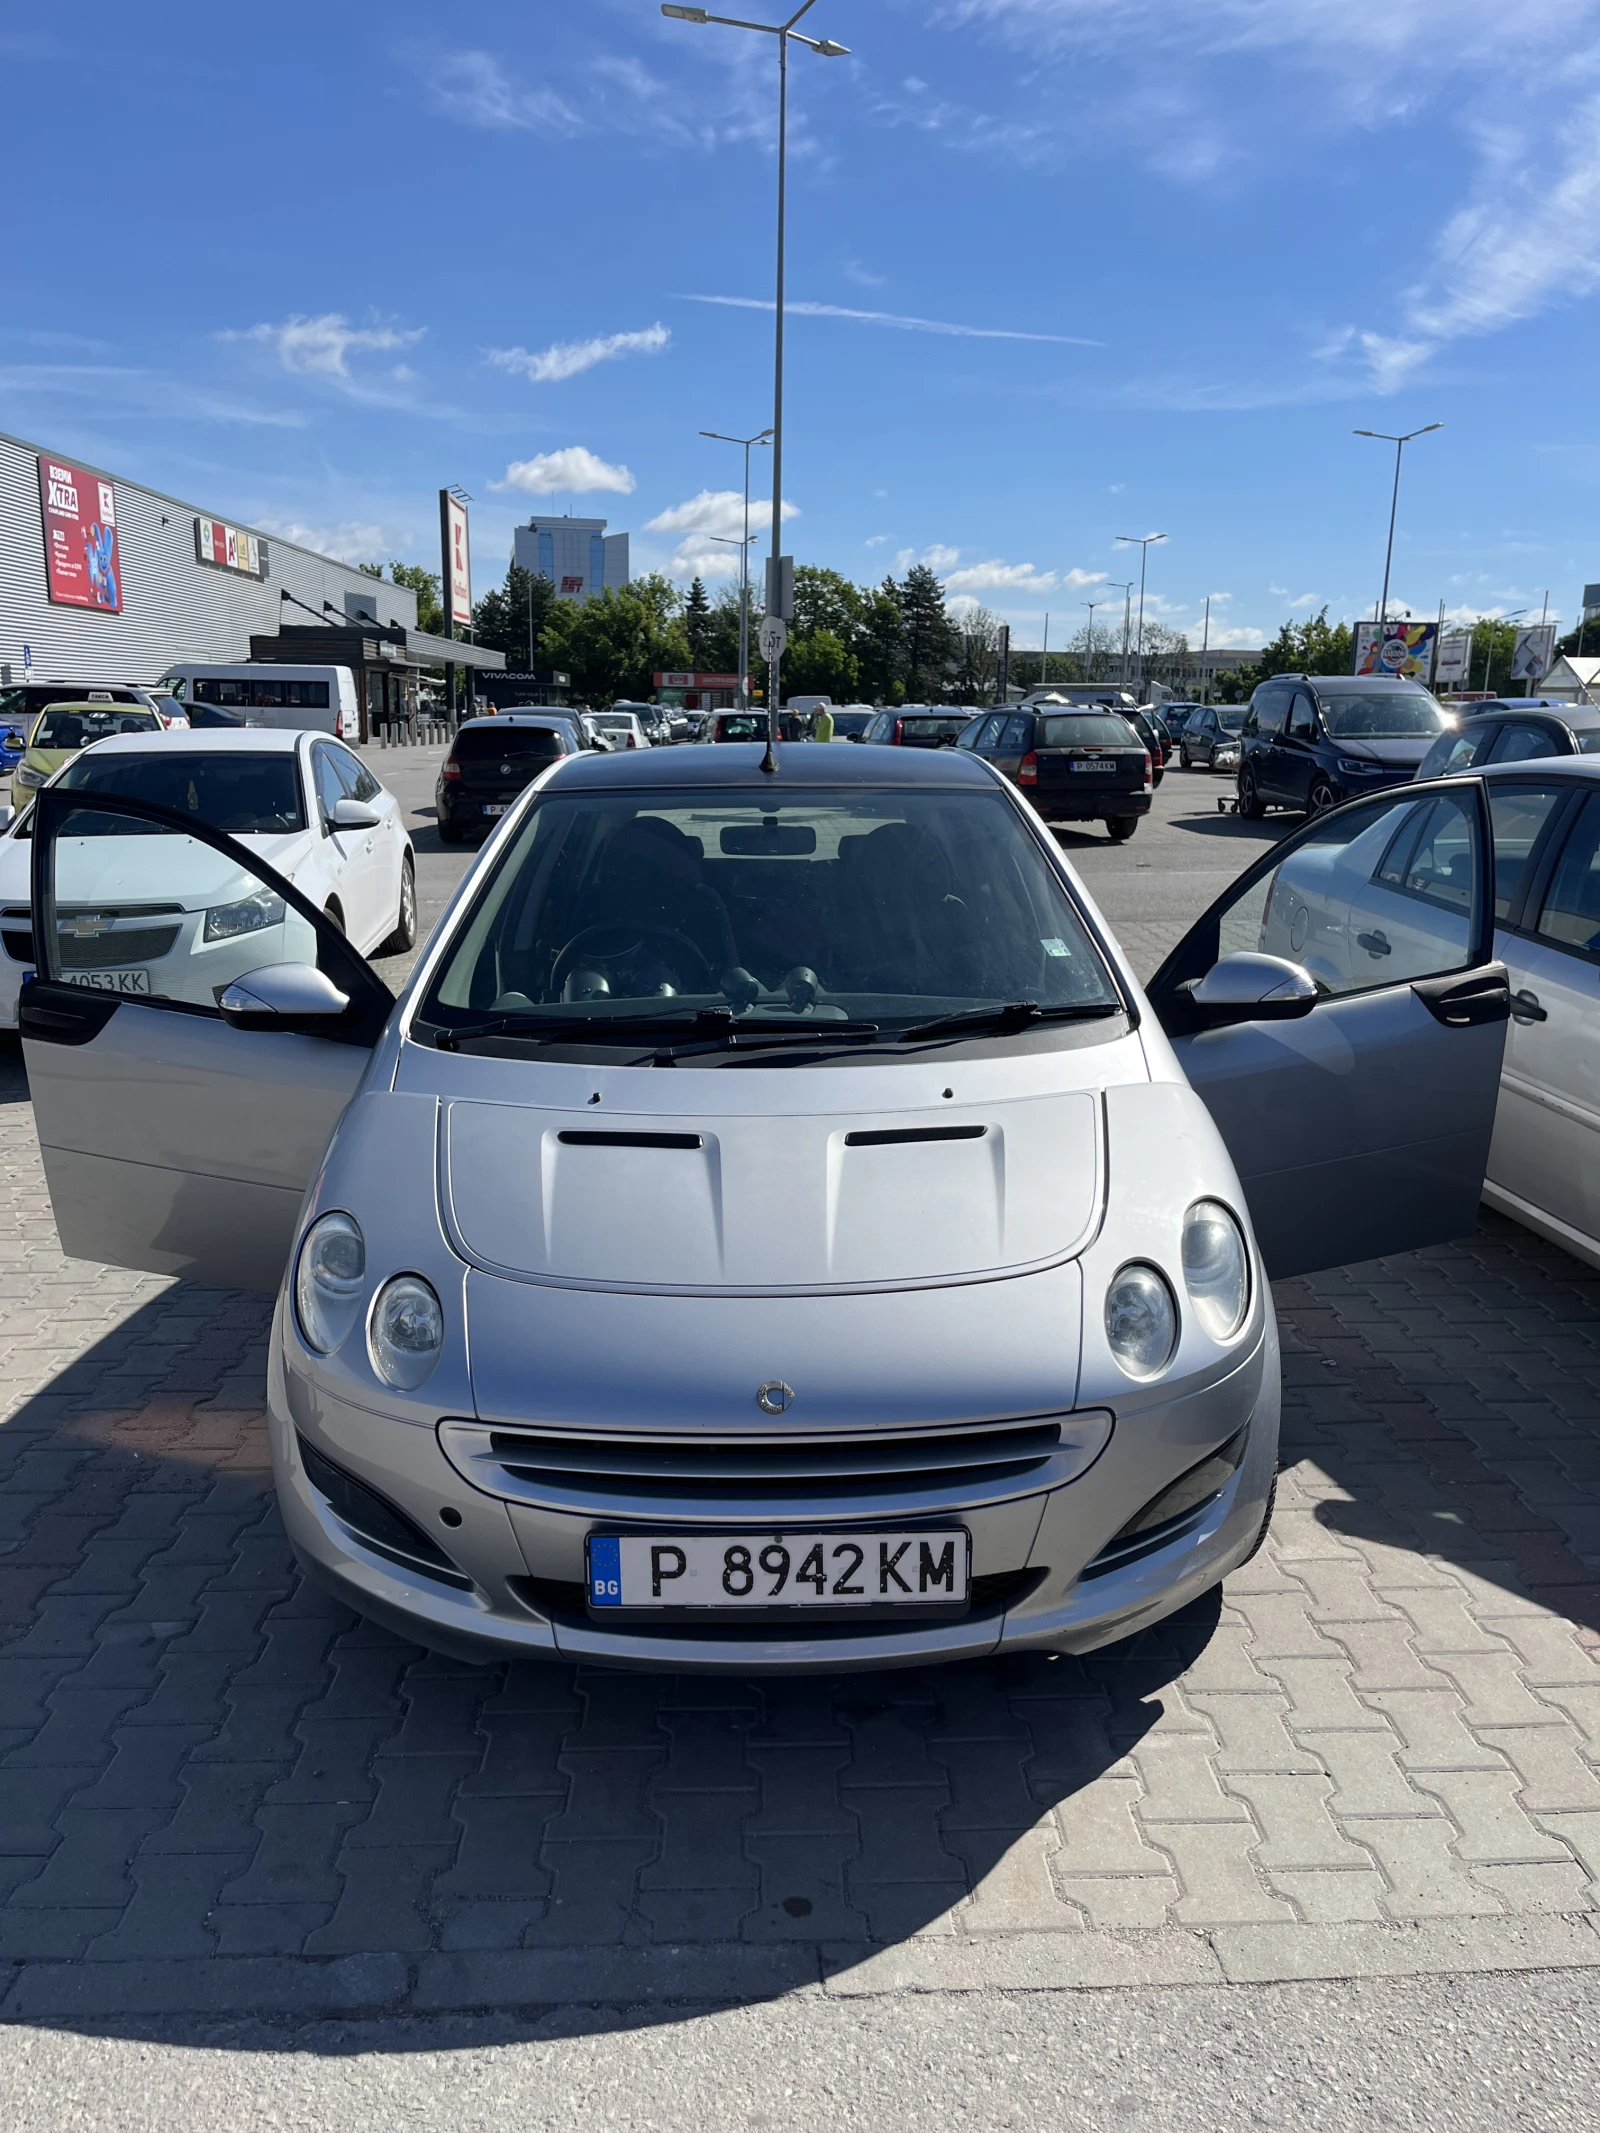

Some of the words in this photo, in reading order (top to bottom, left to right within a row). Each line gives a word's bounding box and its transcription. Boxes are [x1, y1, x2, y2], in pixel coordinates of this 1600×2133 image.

[47, 480, 79, 513] XTRA
[228, 534, 237, 562] A1
[482, 672, 537, 680] VIVACOM
[1077, 762, 1083, 770] P
[490, 805, 496, 814] P
[594, 1580, 619, 1596] BG
[650, 1545, 687, 1597] P
